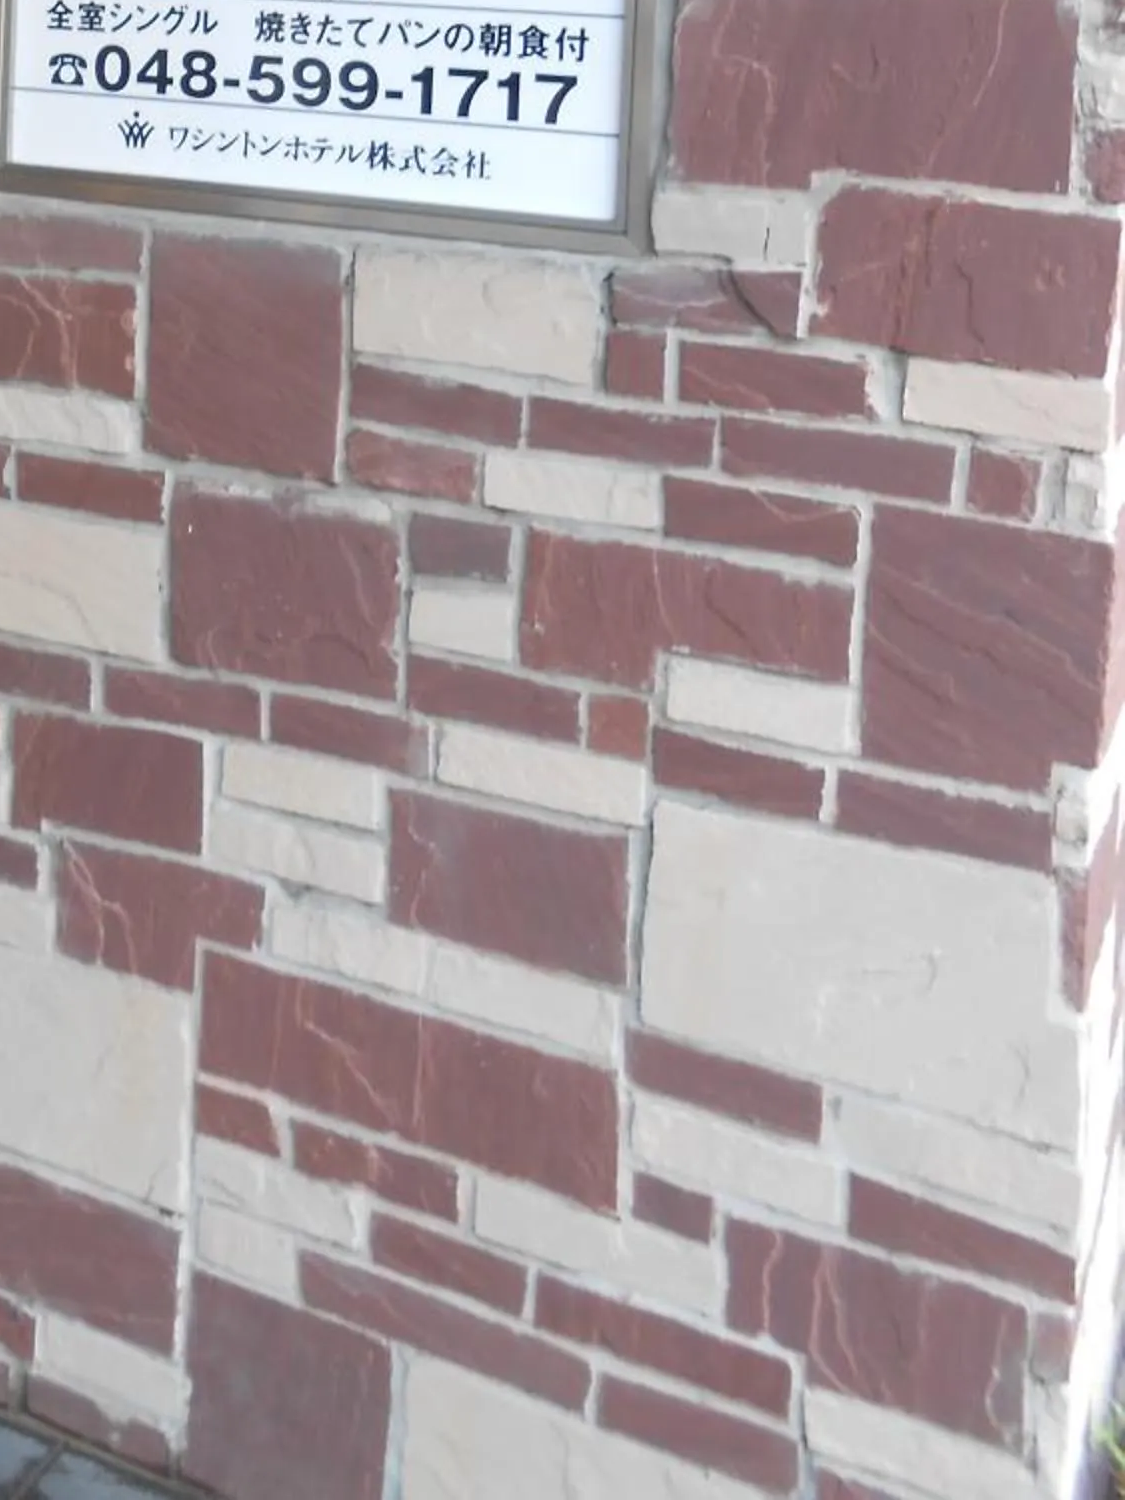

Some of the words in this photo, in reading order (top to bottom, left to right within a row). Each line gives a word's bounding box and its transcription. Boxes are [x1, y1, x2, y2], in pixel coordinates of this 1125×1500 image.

[46, 0, 218, 35] 全室シングル
[254, 10, 590, 62] 焼きたてパンの朝食付
[94, 45, 579, 125] 048-599-1717
[169, 125, 492, 181] ワシントンホテル株式会社
